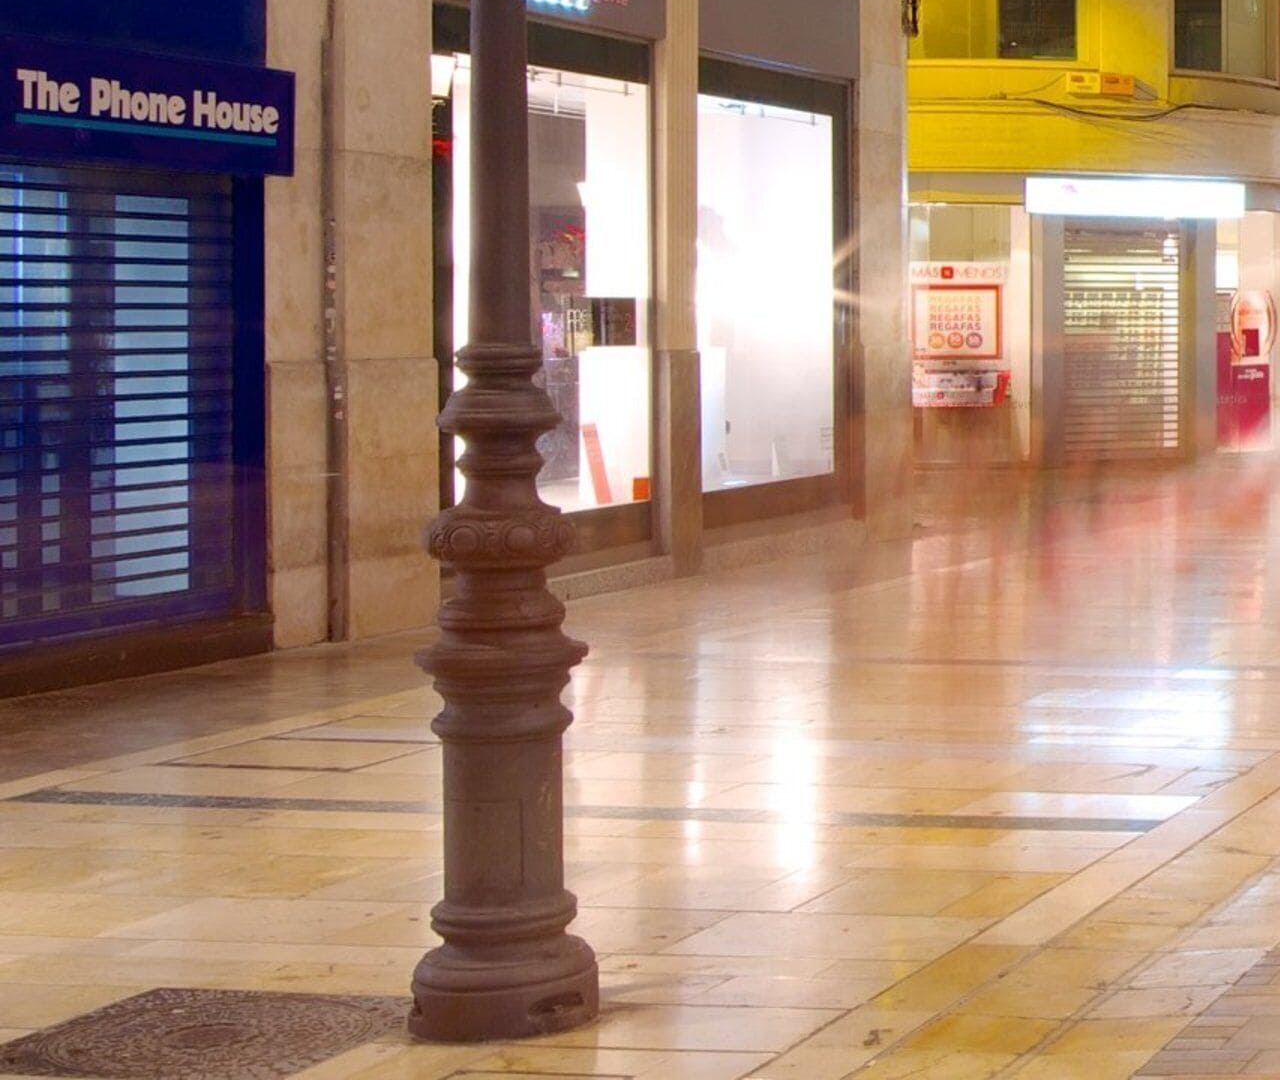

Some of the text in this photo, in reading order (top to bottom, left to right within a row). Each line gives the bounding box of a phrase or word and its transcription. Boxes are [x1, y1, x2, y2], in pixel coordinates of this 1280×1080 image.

[16, 68, 280, 135] The Phone House
[929, 322, 982, 331] REGAFAS
